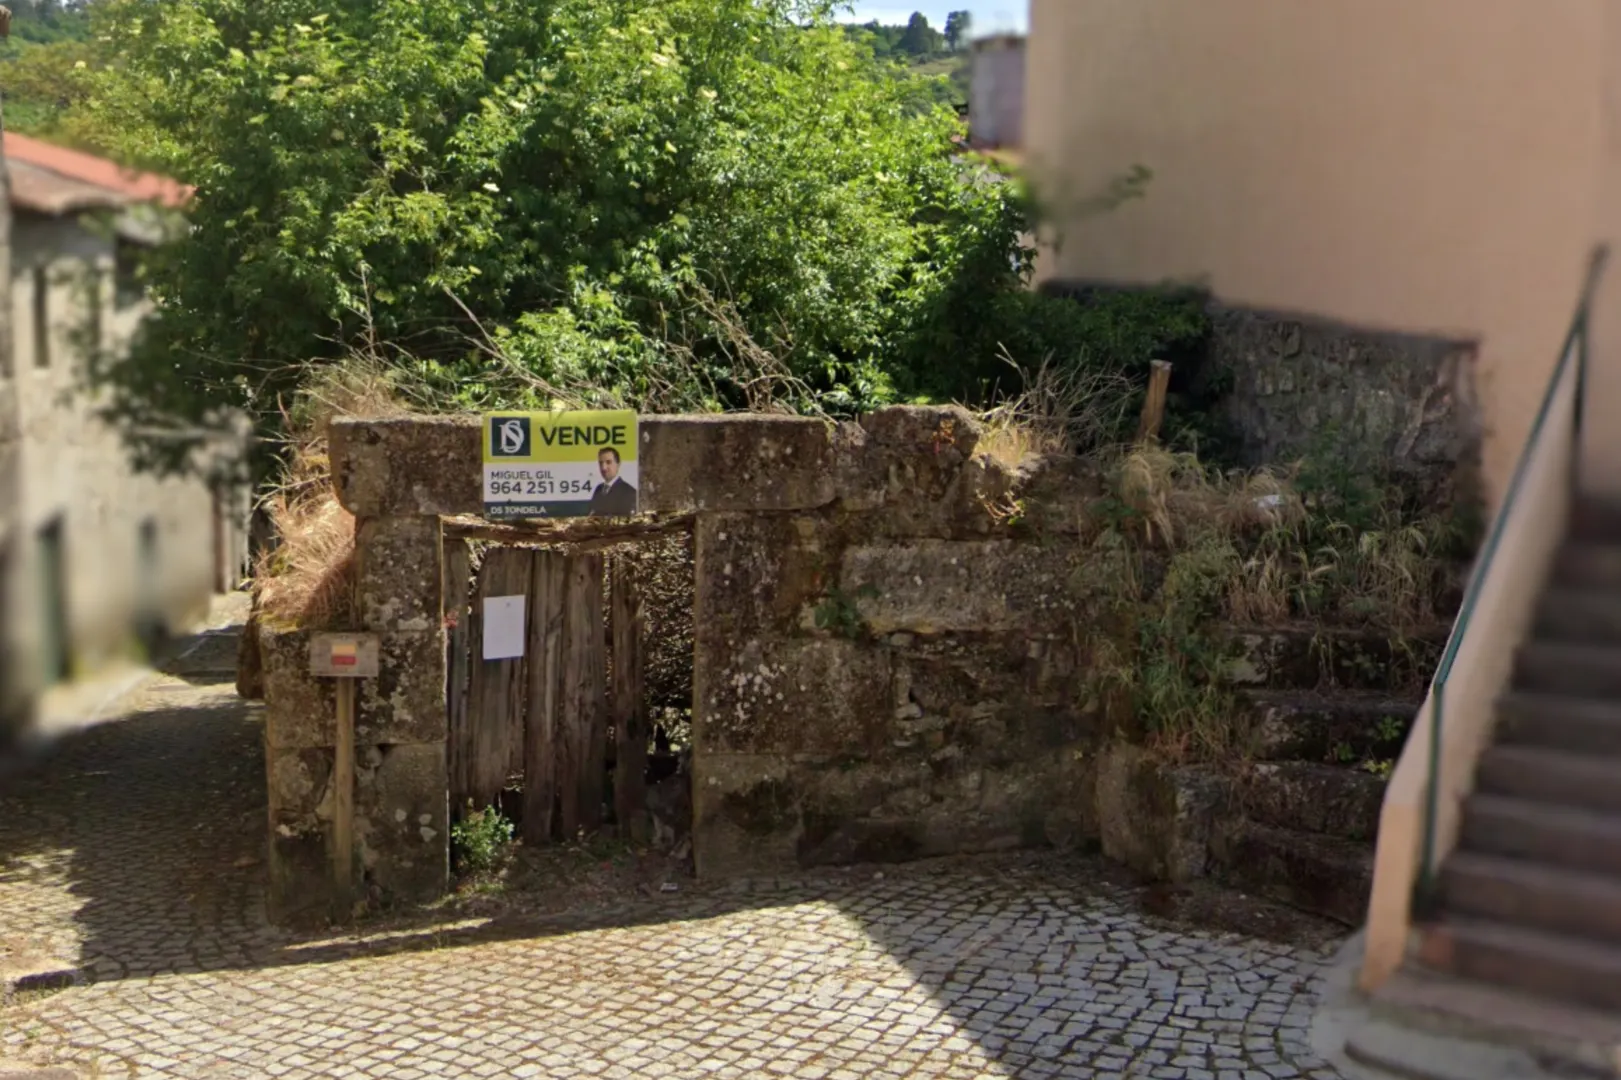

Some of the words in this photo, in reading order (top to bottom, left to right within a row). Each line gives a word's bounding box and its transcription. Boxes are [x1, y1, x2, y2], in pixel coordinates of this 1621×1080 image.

[540, 425, 627, 446] VENDE
[490, 471, 532, 480] MIGUEL
[535, 470, 554, 479] GIL
[490, 481, 522, 495] 964
[526, 481, 555, 494] 251
[559, 480, 592, 493] 954
[504, 506, 547, 514] TONDELA
